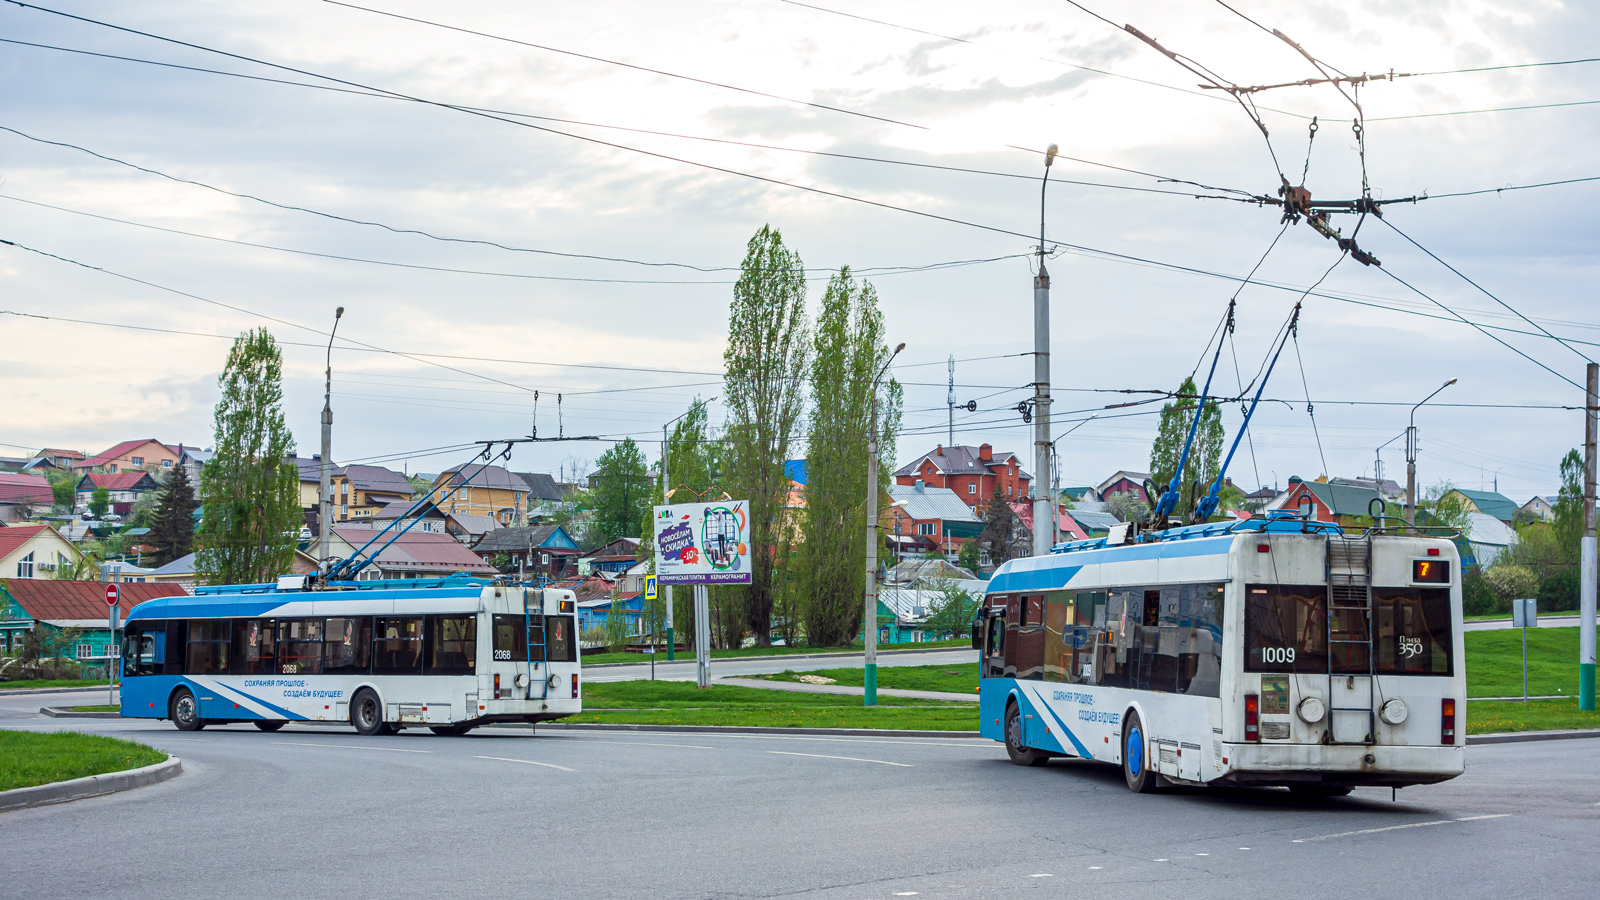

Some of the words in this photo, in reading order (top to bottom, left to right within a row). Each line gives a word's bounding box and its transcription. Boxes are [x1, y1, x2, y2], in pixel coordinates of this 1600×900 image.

[658, 510, 673, 518] ДИВА
[661, 529, 690, 543] НОВОСЁЛАМ
[665, 539, 689, 552] СКИДКА
[1421, 562, 1430, 576] 7
[560, 601, 565, 610] 7
[494, 649, 511, 660] 2068
[1262, 646, 1295, 663] 1009
[1398, 643, 1423, 659] 350
[282, 664, 297, 673] 2068
[244, 679, 274, 687] СОХРАНЯЯ
[283, 689, 311, 698] СОЗДАЁМ
[312, 690, 344, 699] БУДУЩЕЕ!
